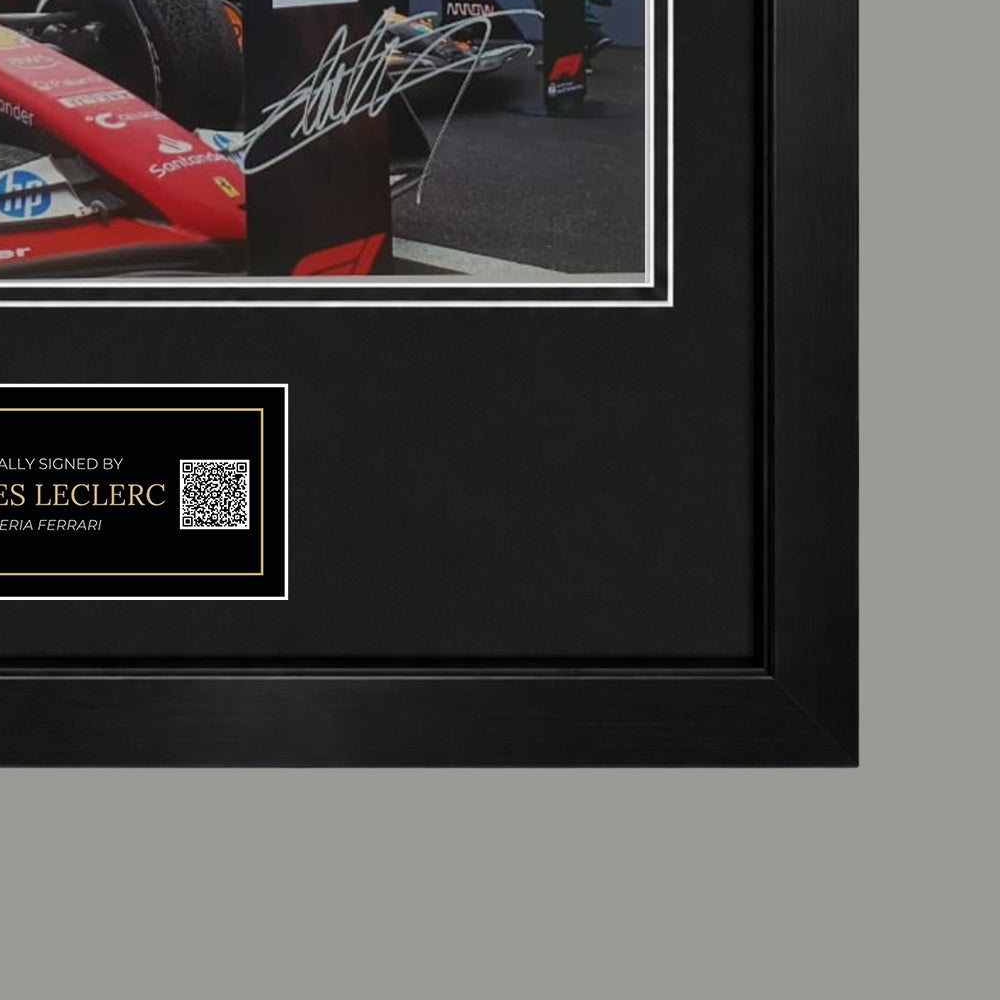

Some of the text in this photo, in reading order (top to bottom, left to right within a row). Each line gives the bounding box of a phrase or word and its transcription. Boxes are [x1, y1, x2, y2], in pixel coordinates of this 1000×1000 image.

[149, 152, 238, 179] Santand
[0, 170, 47, 217] hp
[38, 458, 99, 470] SIGNED
[103, 458, 123, 470] BY
[35, 483, 166, 507] LECLERC
[38, 519, 102, 531] FERRARI
